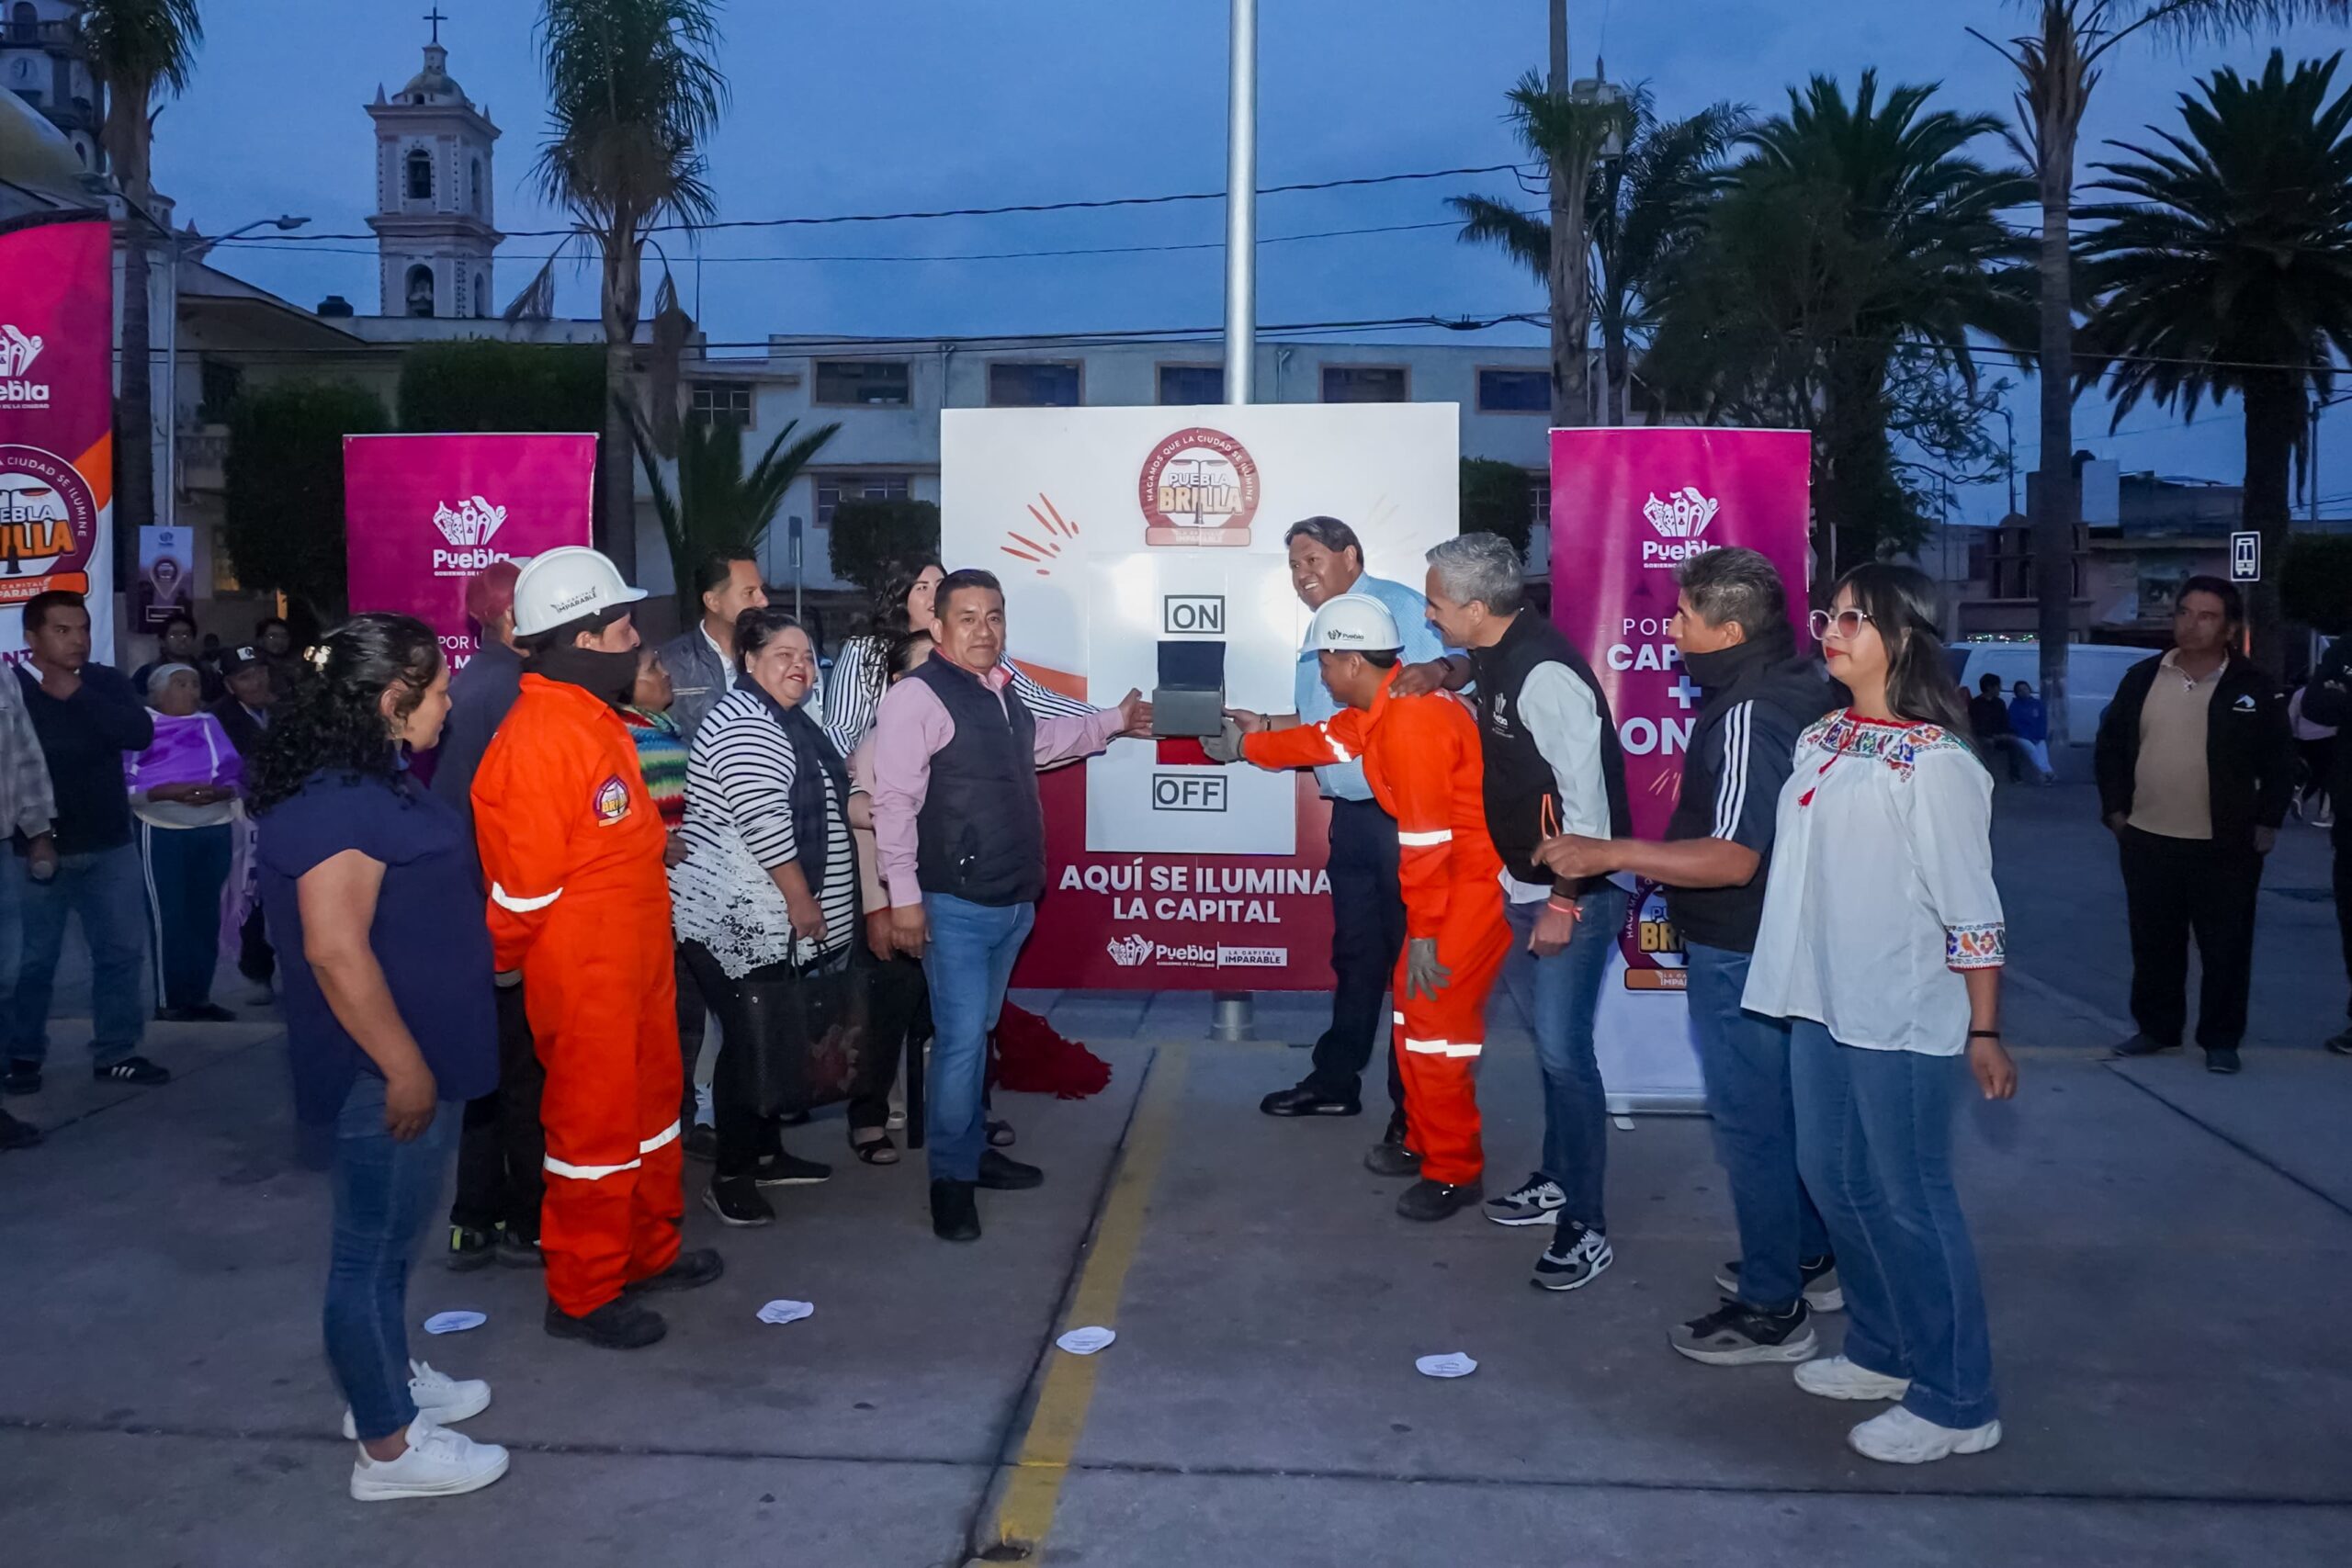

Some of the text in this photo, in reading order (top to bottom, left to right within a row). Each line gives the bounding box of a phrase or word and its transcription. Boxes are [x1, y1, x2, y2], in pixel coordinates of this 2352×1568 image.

[1146, 435, 1254, 502] HAGAMOS QUE LA CIUDAD SE ILUMINE
[1169, 472, 1229, 487] PUEBLA
[7, 457, 88, 537] CIUDAD SE ILUMINE
[1159, 486, 1243, 514] BRILLA
[1643, 539, 1722, 561] Puebl
[1172, 604, 1218, 629] ON
[437, 636, 469, 649] POR
[1156, 779, 1220, 807] OFF
[1058, 856, 1332, 896] AQUÍ SE ILUMINA
[1114, 897, 1281, 923] LA CAPITAL
[1625, 885, 1645, 939] HAGAMOS
[1156, 944, 1216, 962] Puebla
[1225, 955, 1282, 964] IMPARABLE
